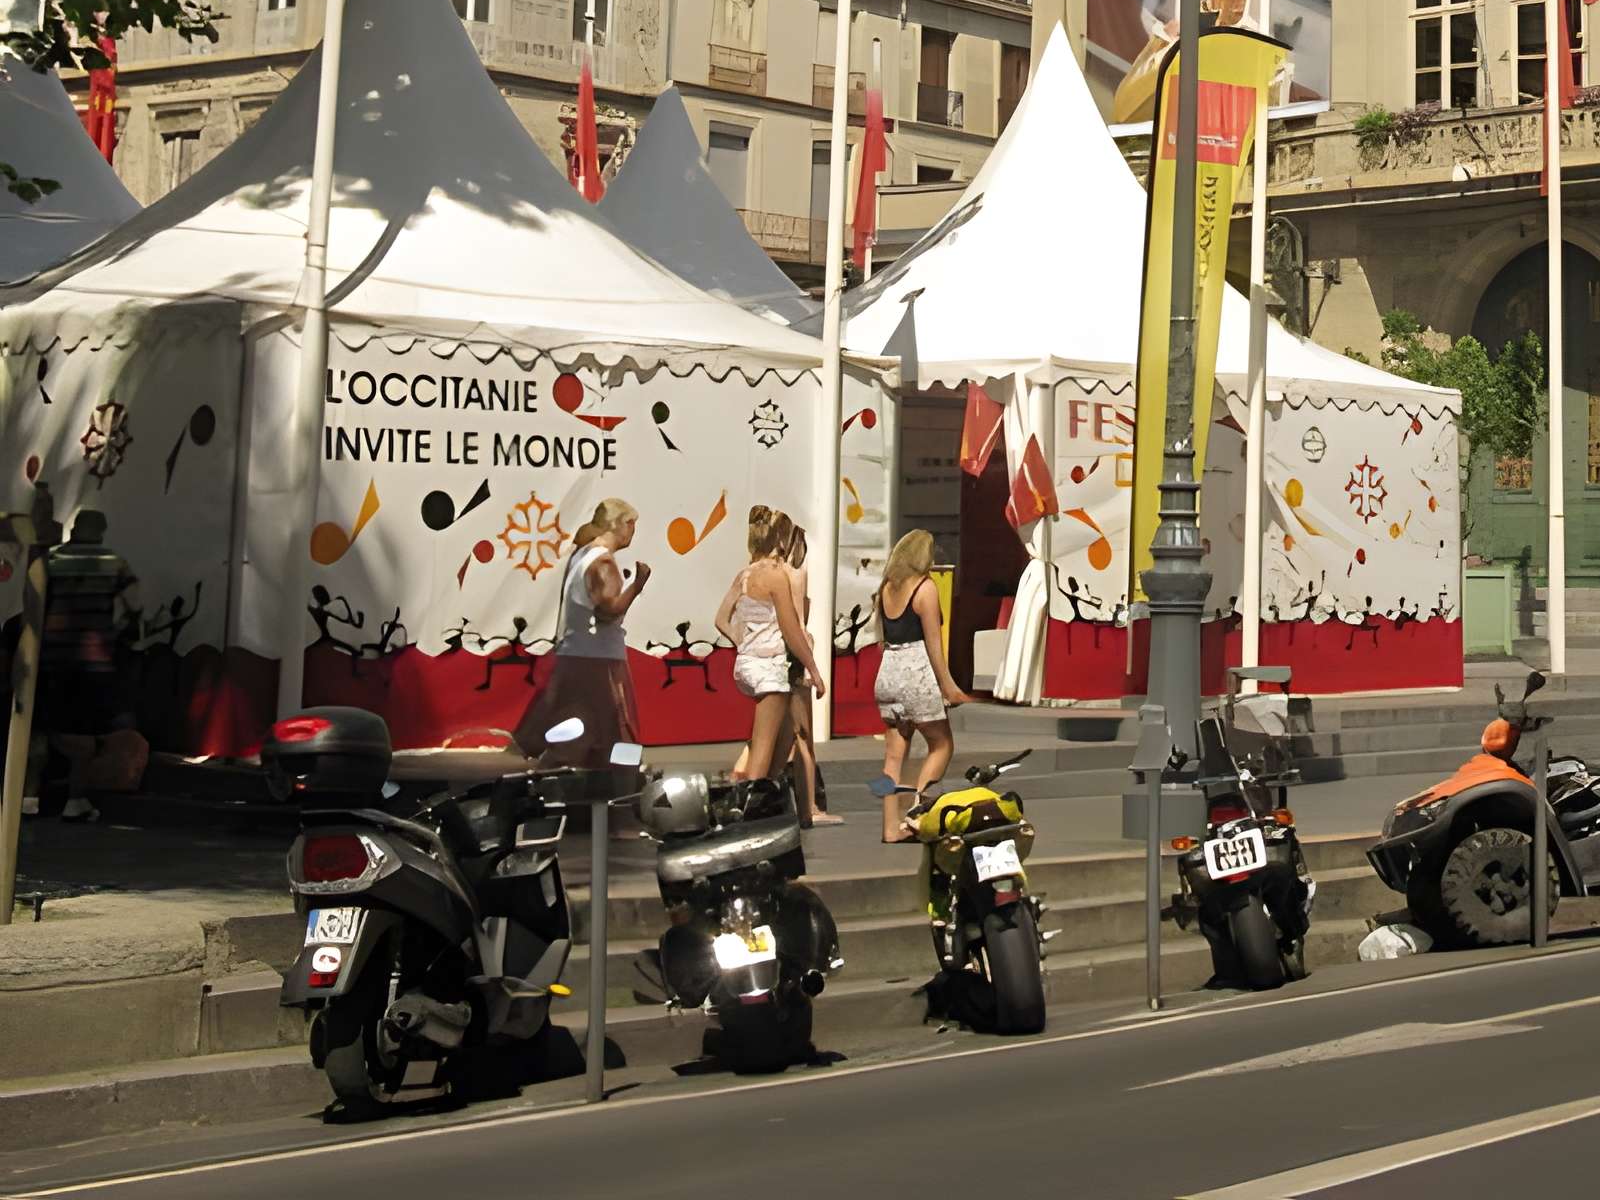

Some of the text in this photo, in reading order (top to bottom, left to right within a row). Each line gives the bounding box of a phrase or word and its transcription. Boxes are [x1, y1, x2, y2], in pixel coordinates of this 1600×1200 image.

[326, 368, 538, 413] L'OCCITANIE
[325, 426, 617, 470] INVITE LE MONDE
